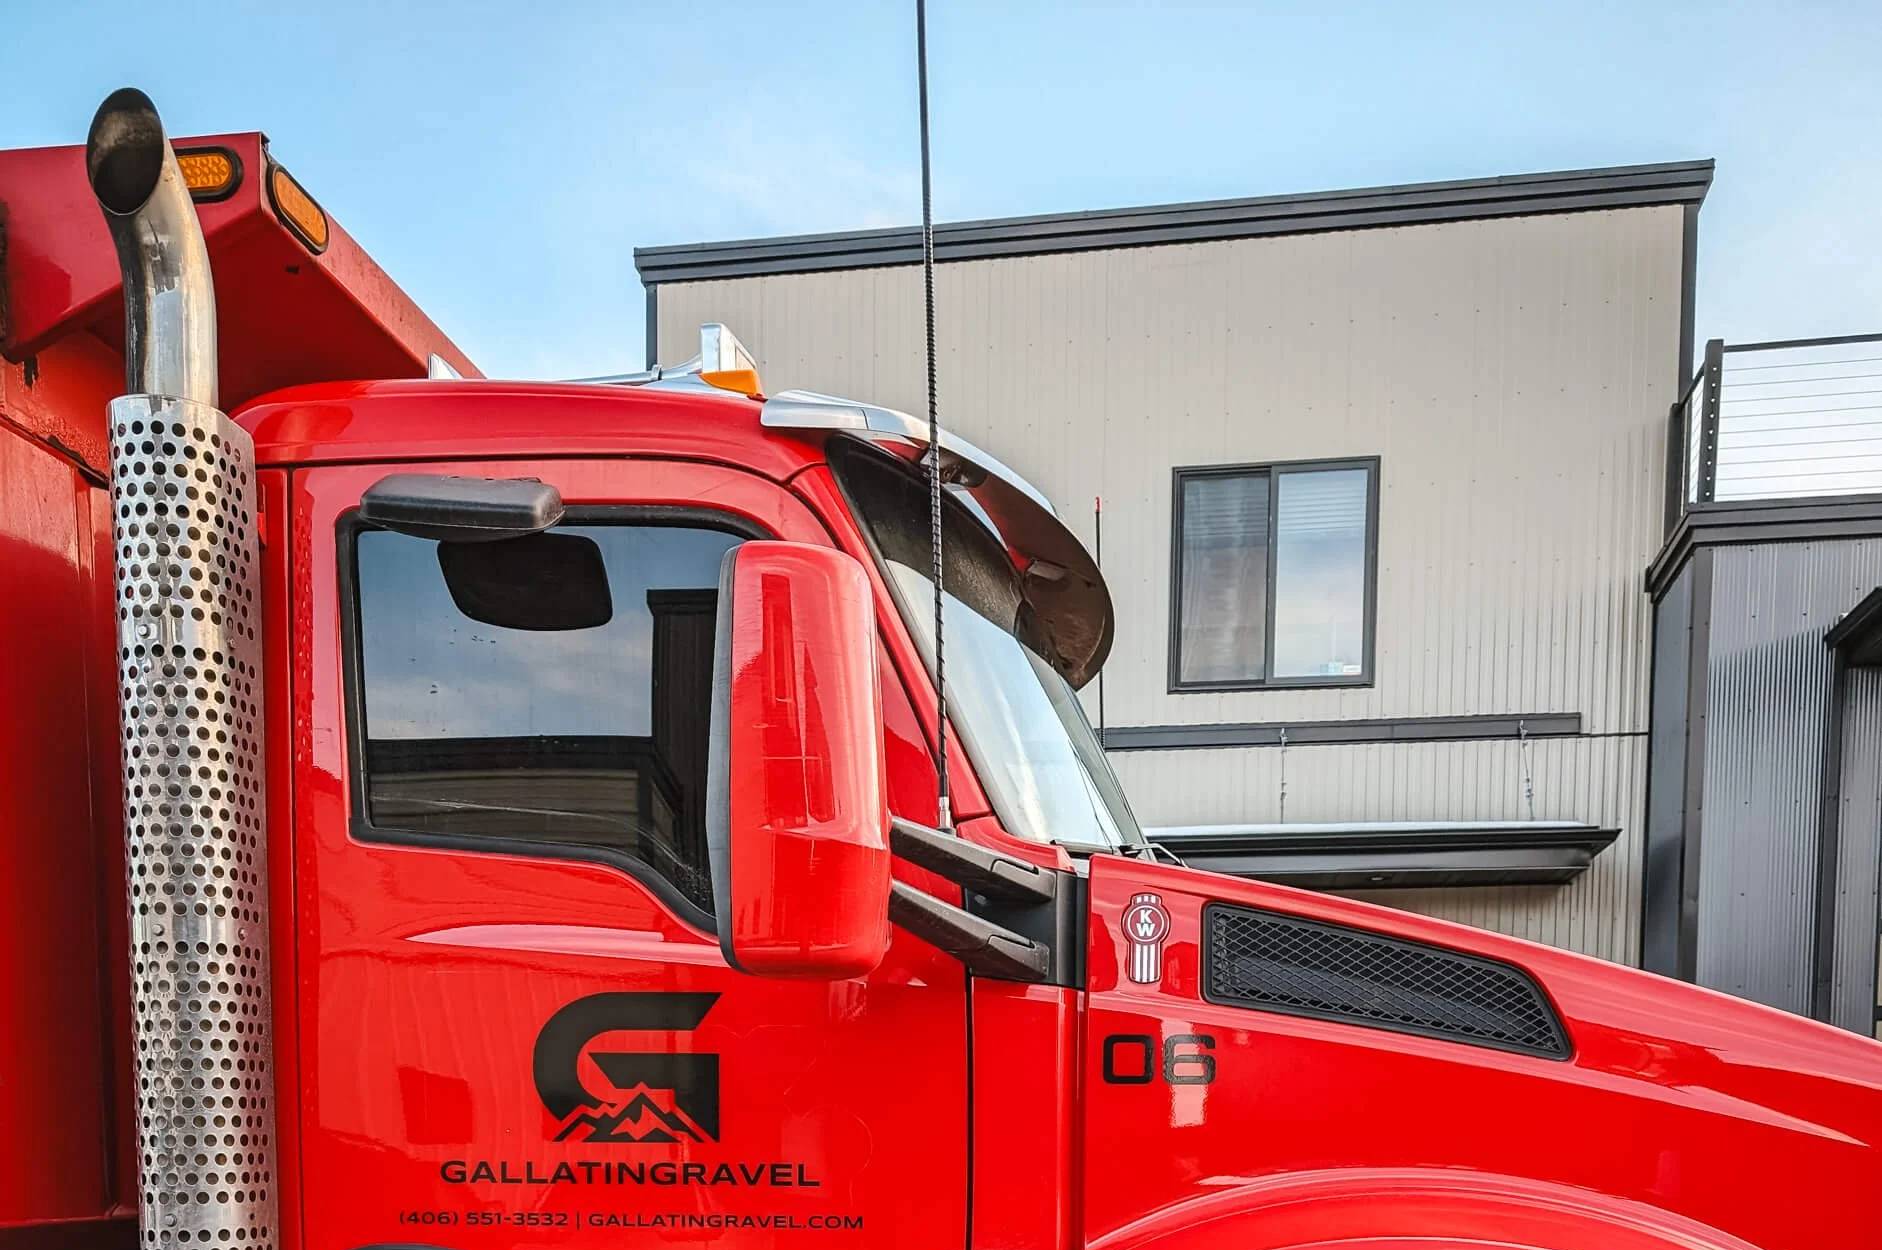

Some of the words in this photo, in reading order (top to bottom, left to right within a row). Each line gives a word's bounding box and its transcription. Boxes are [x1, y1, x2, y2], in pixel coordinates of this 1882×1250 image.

[1103, 1034, 1217, 1085] 06
[439, 1160, 821, 1187] GALLATINGRAVEL
[399, 1211, 459, 1226] (406)
[466, 1212, 568, 1227] 551-3532
[588, 1213, 864, 1230] GALLATINGRAVEL.COM
